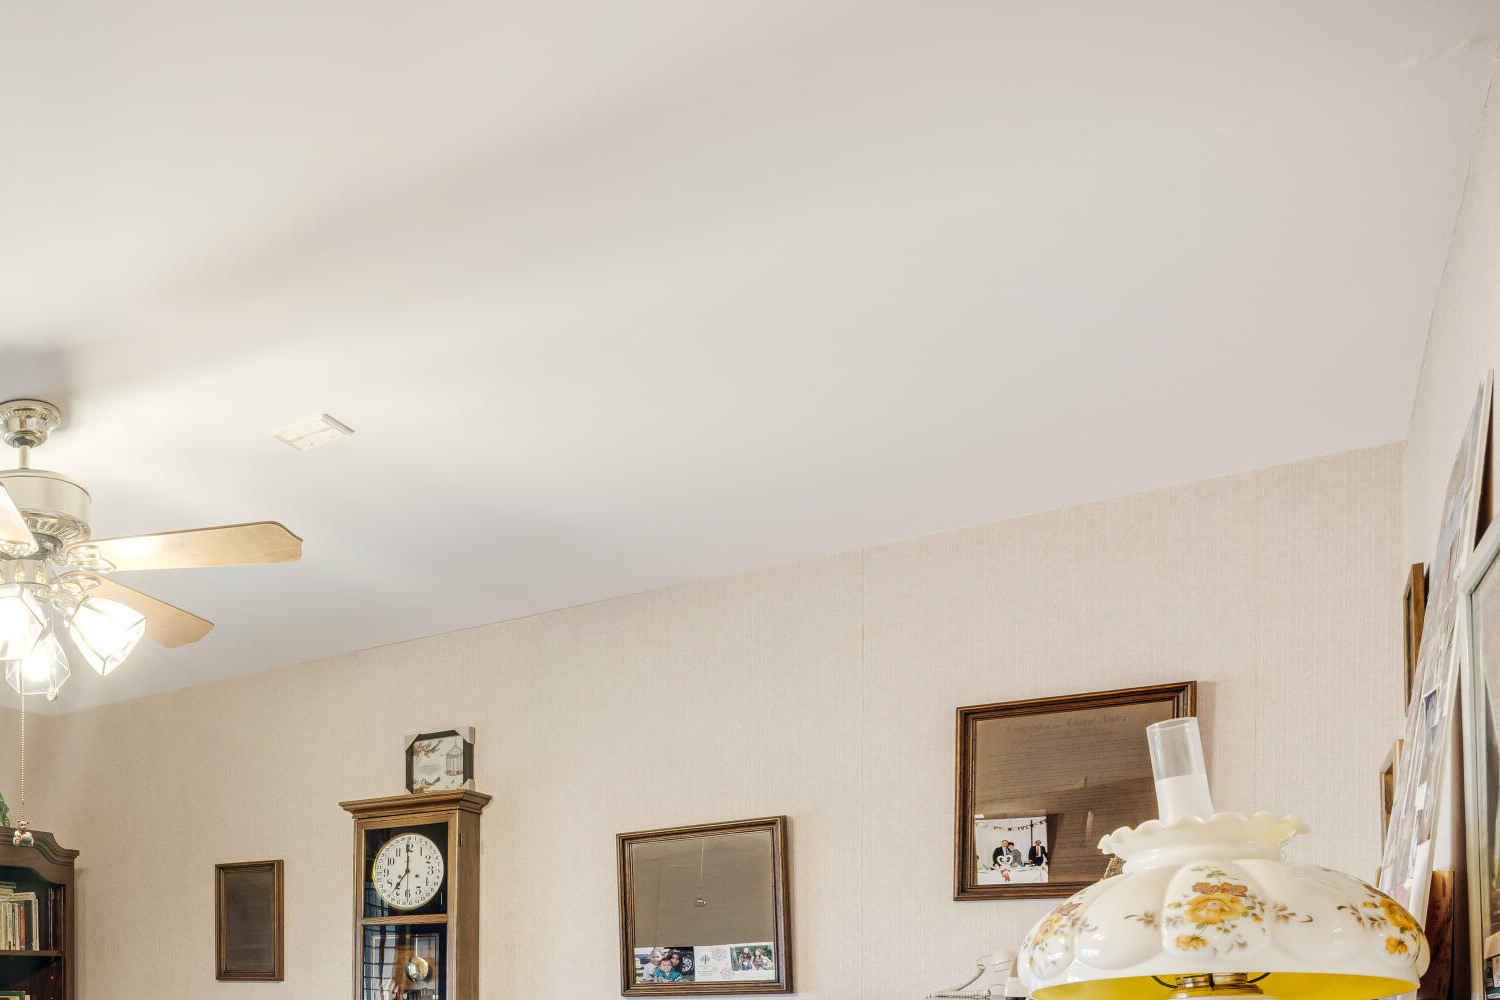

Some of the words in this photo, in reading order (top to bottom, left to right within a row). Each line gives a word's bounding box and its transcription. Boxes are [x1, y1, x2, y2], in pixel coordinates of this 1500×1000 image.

[395, 847, 401, 857] 11
[419, 846, 423, 856] 1
[387, 857, 395, 866] 10
[425, 855, 432, 864] 2
[383, 868, 390, 877] 9
[427, 866, 434, 876] 3
[404, 889, 411, 899] 6
[415, 886, 422, 895] 5
